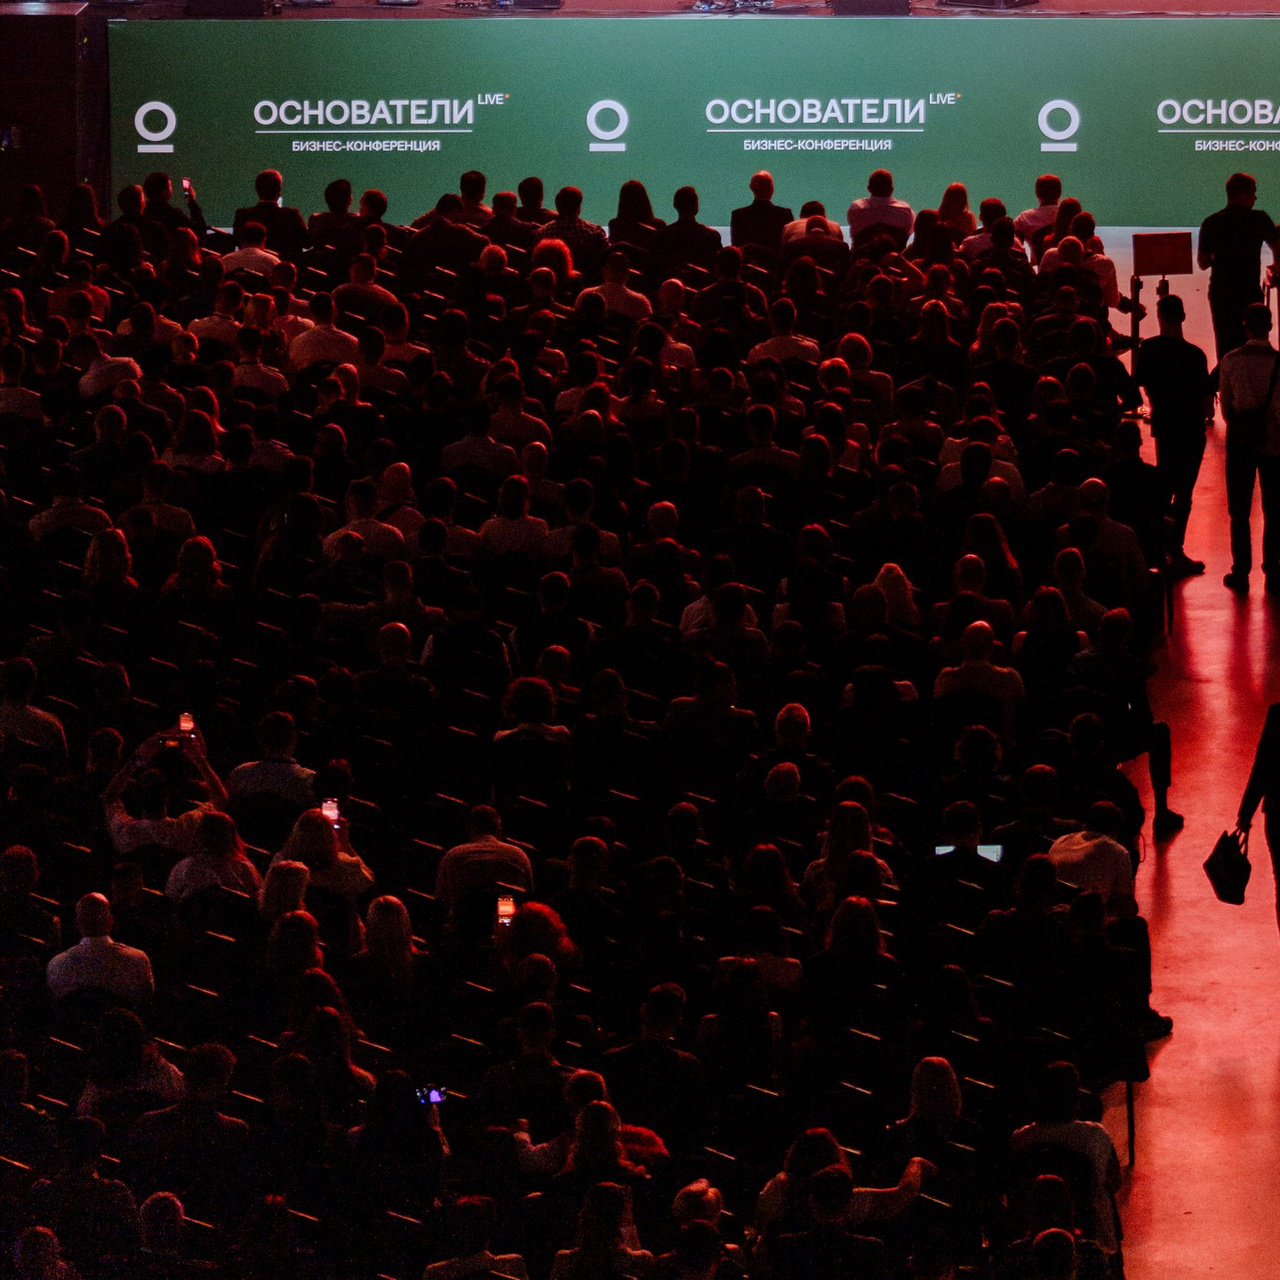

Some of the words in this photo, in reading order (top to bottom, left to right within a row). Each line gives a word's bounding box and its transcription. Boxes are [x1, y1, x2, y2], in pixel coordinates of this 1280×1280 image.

[253, 99, 474, 126] ОСНОВАТЕЛИ
[705, 98, 925, 125] ОСНОВАТЕЛИ
[292, 140, 440, 153] БИЗНЕС-КОНФЕРЕНЦИЯ
[743, 139, 892, 152] БИЗНЕС-КОНФЕРЕНЦИЯ
